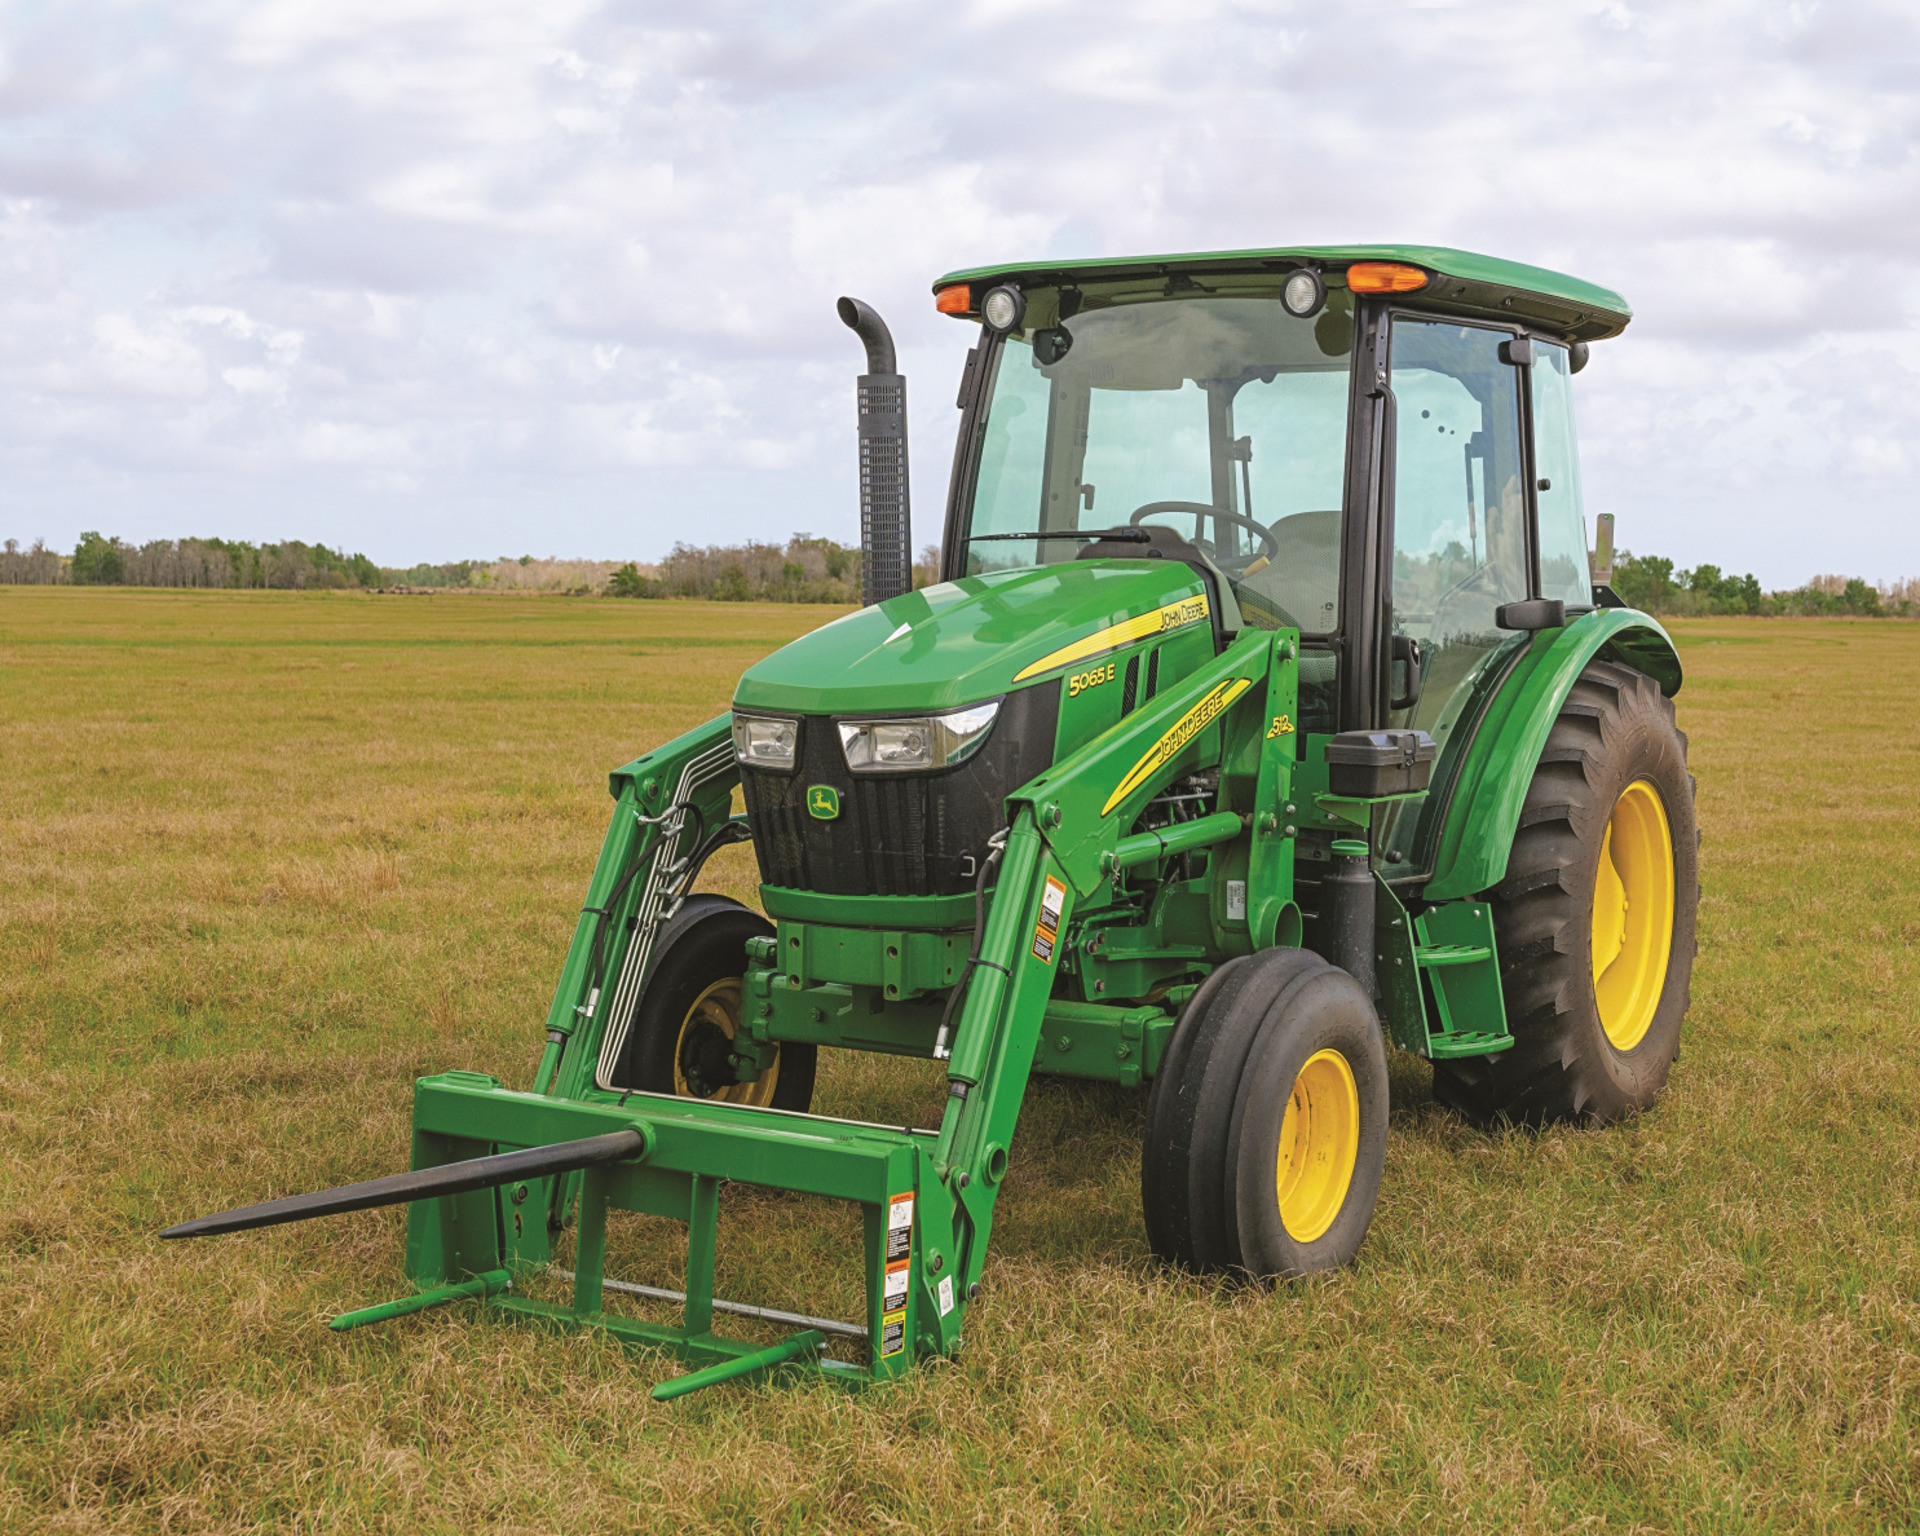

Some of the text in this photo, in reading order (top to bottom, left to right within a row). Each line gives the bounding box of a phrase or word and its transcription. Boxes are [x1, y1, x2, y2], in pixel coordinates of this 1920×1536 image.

[1160, 602, 1205, 630] JOHN DEERE
[1069, 662, 1116, 698] 5065 E
[1158, 690, 1224, 763] JOHN DEERE
[1272, 714, 1289, 735] 512
